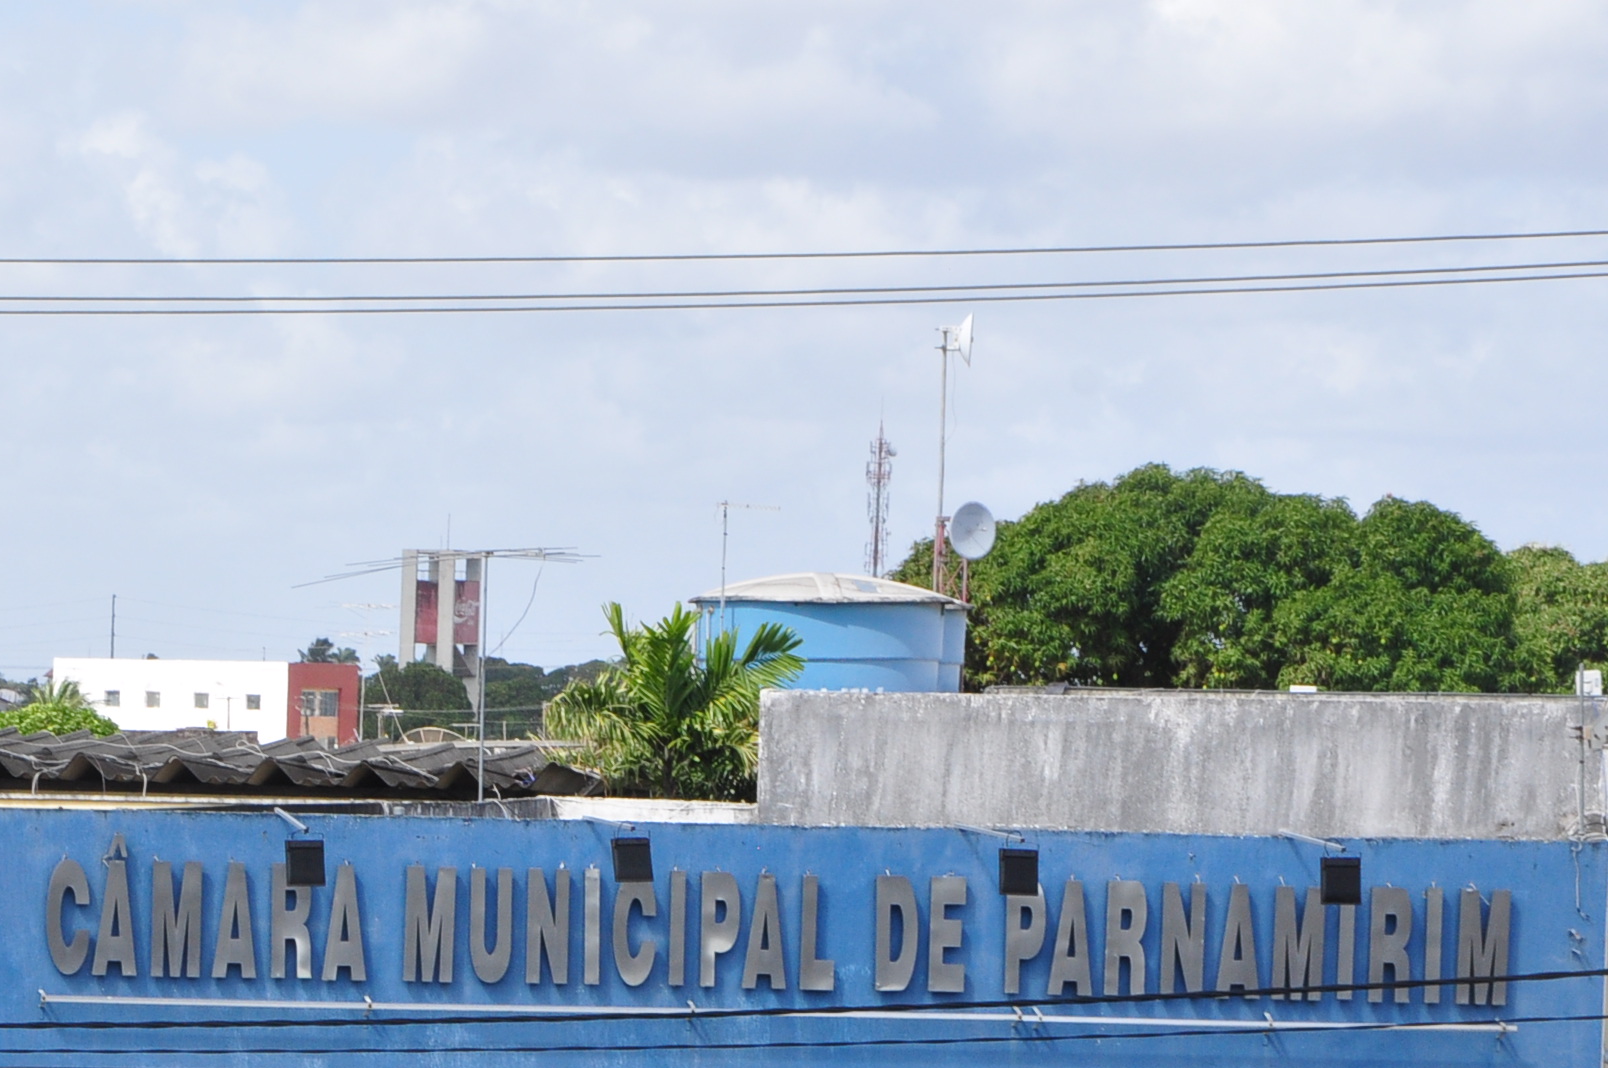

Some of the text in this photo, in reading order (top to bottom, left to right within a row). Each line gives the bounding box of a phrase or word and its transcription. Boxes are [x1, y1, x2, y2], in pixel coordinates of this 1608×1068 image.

[45, 833, 1511, 1006] CÂMARA MUNICIPAL DE PARNAMIRIM
